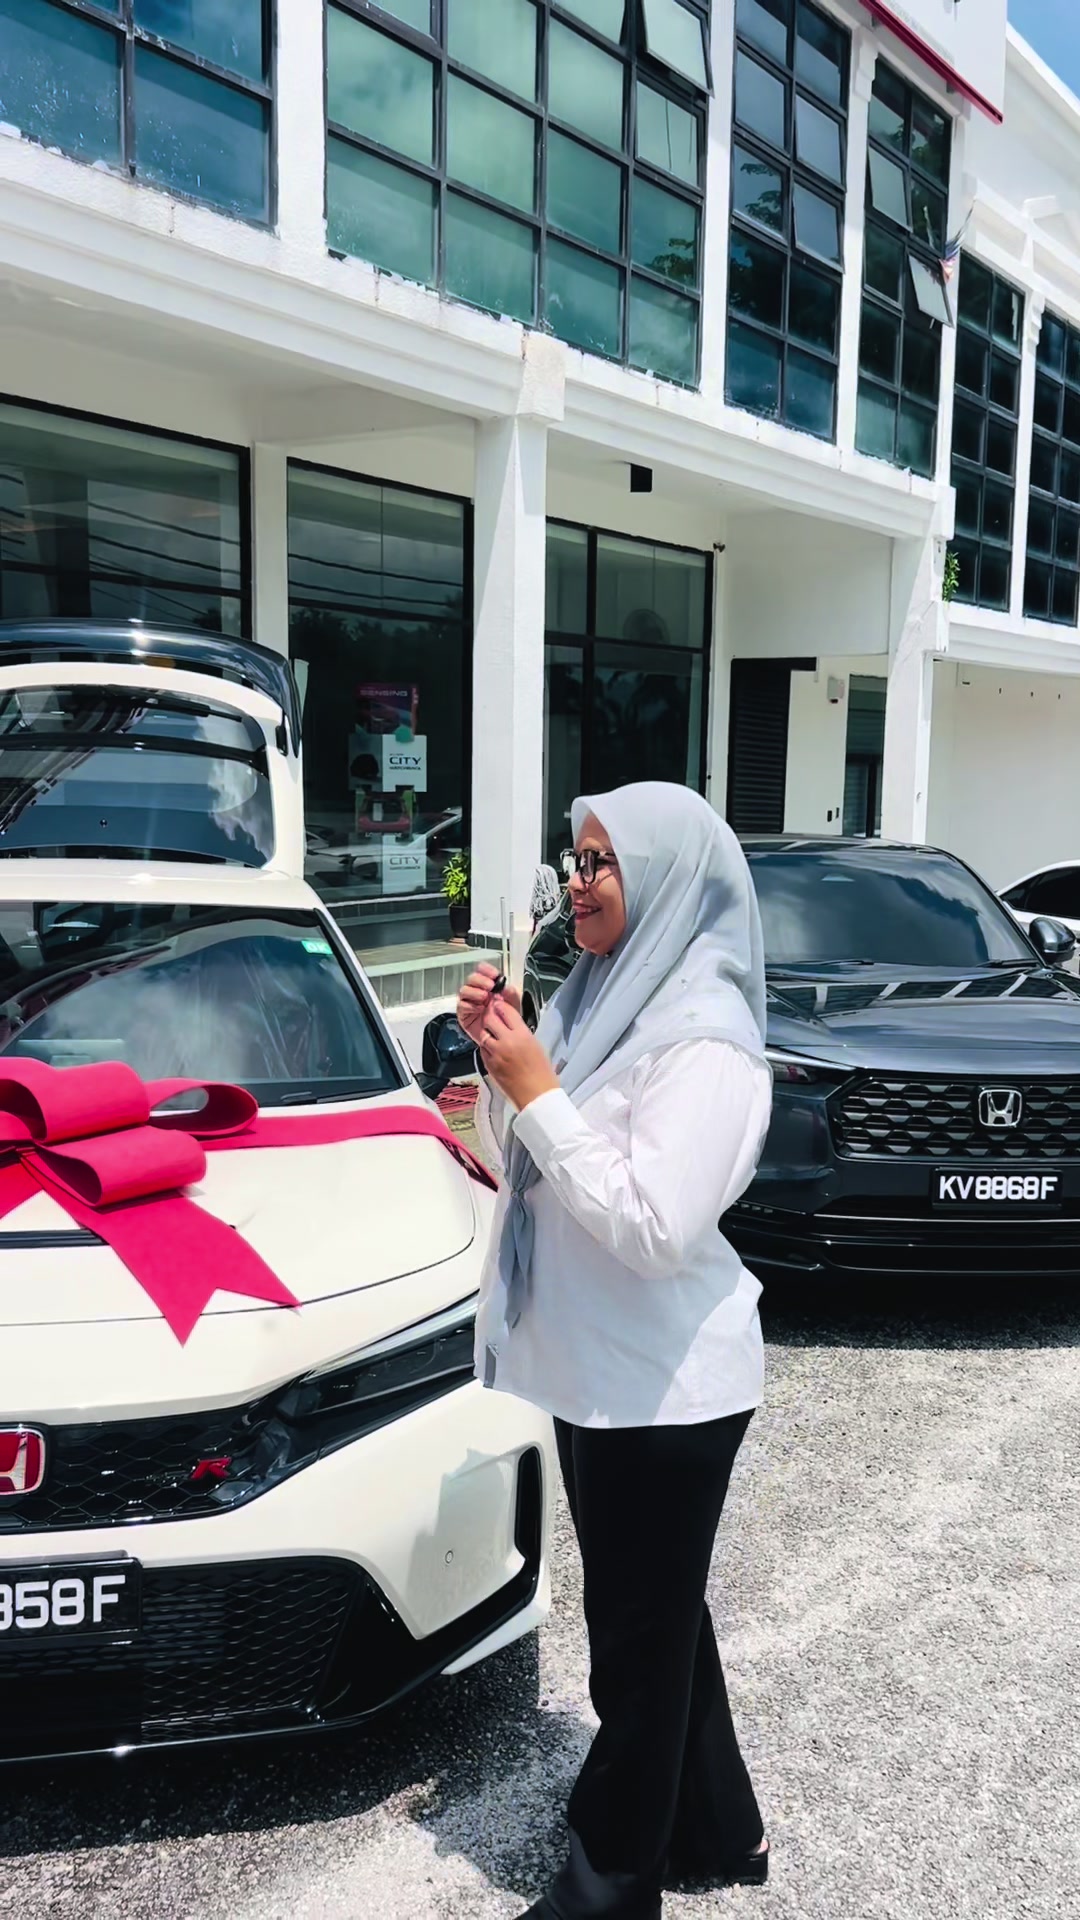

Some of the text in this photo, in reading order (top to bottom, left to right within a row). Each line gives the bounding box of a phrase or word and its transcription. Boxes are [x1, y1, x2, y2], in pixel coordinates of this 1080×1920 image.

[389, 756, 422, 765] CITY
[389, 856, 421, 865] CITY
[939, 1175, 1058, 1200] KV8868F
